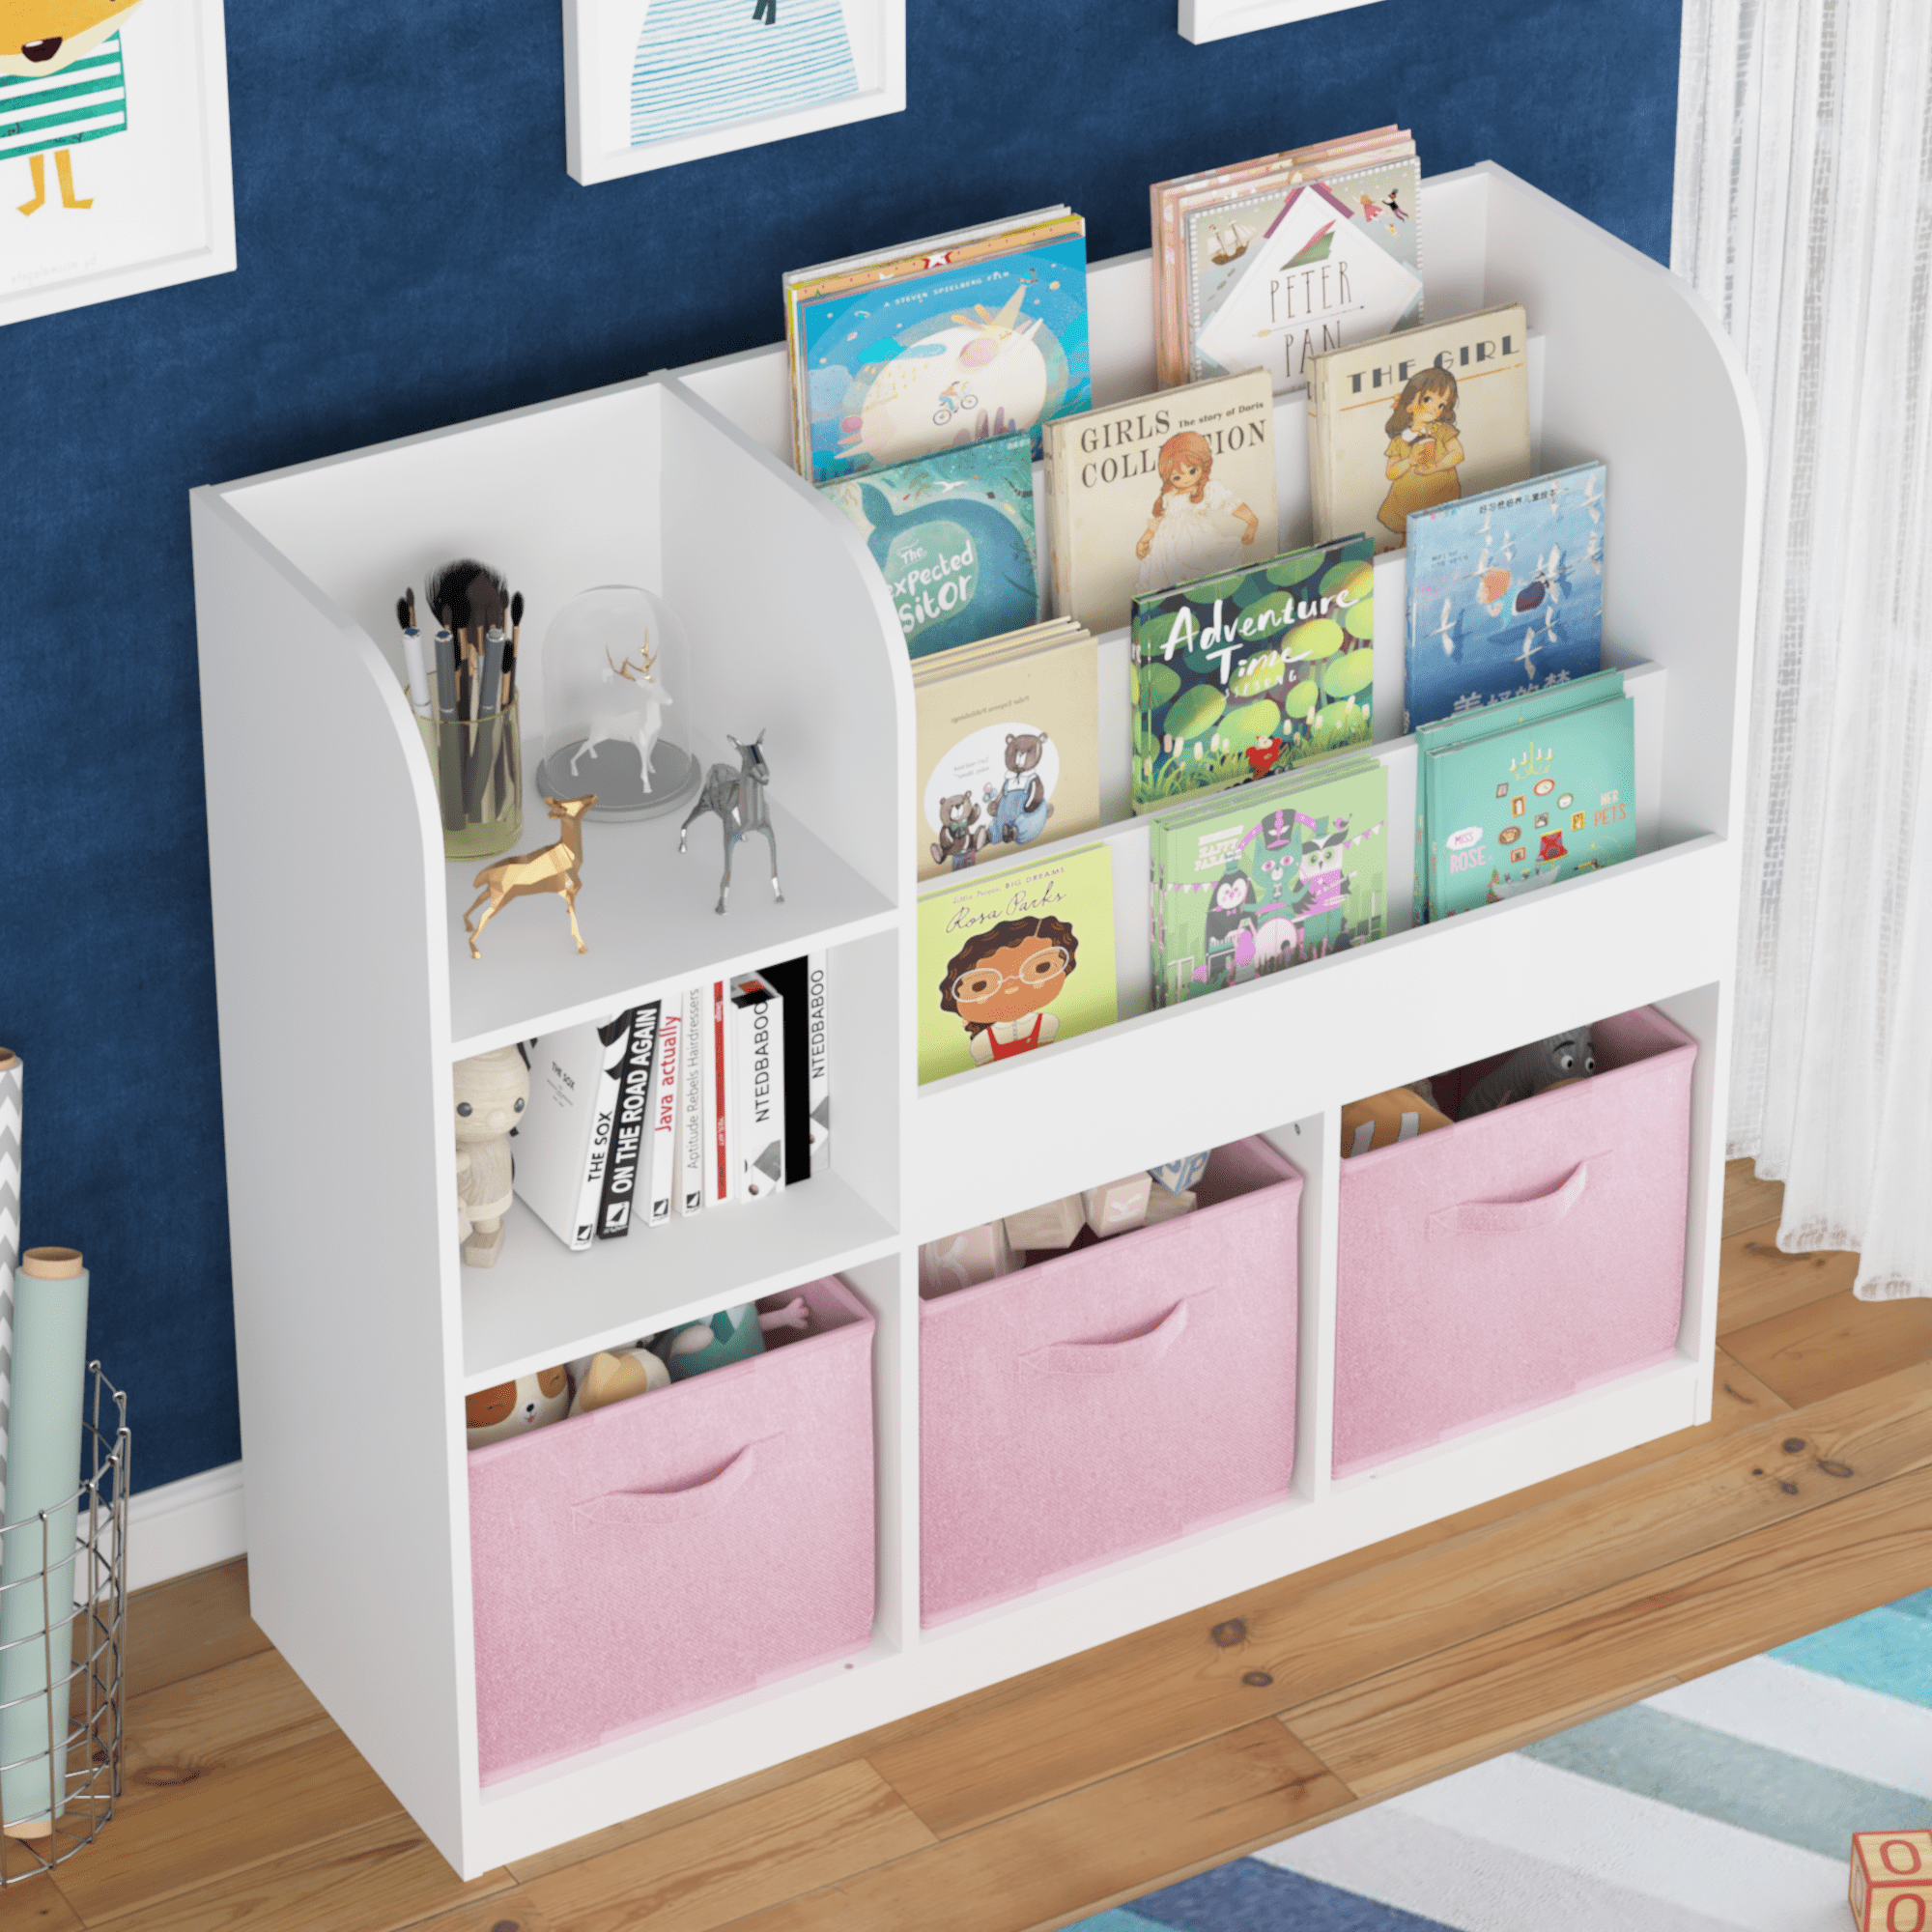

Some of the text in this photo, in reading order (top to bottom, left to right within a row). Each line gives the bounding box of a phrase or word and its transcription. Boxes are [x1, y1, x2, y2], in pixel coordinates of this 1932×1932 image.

[895, 292, 928, 305] STEVEN
[932, 278, 983, 296] SPIELBERG
[1269, 260, 1351, 323] PETER
[1284, 320, 1342, 379] PAN
[1347, 334, 1520, 394] THE GIRL
[1080, 410, 1171, 453] GIRLS
[1178, 401, 1264, 428] The story of Doris
[900, 545, 924, 564] The
[1159, 588, 1360, 662] Adventure
[1206, 642, 1313, 685] Time
[1593, 802, 1627, 829] PETS
[1005, 878, 1022, 890] BIG
[1026, 867, 1065, 883] DREAMS
[1450, 845, 1487, 874] ROSE
[946, 880, 1067, 933] Rosa Parks
[631, 1007, 659, 1065] AGAIN
[810, 969, 826, 1080] NTEDBABOO
[621, 1065, 648, 1123] ROAD
[654, 1015, 682, 1132] Java actually
[687, 987, 700, 1170] Aptitude Rebels Hairdressers
[587, 1111, 613, 1183] THE SOX
[615, 1124, 640, 1163] THE
[611, 1164, 635, 1194] ON
